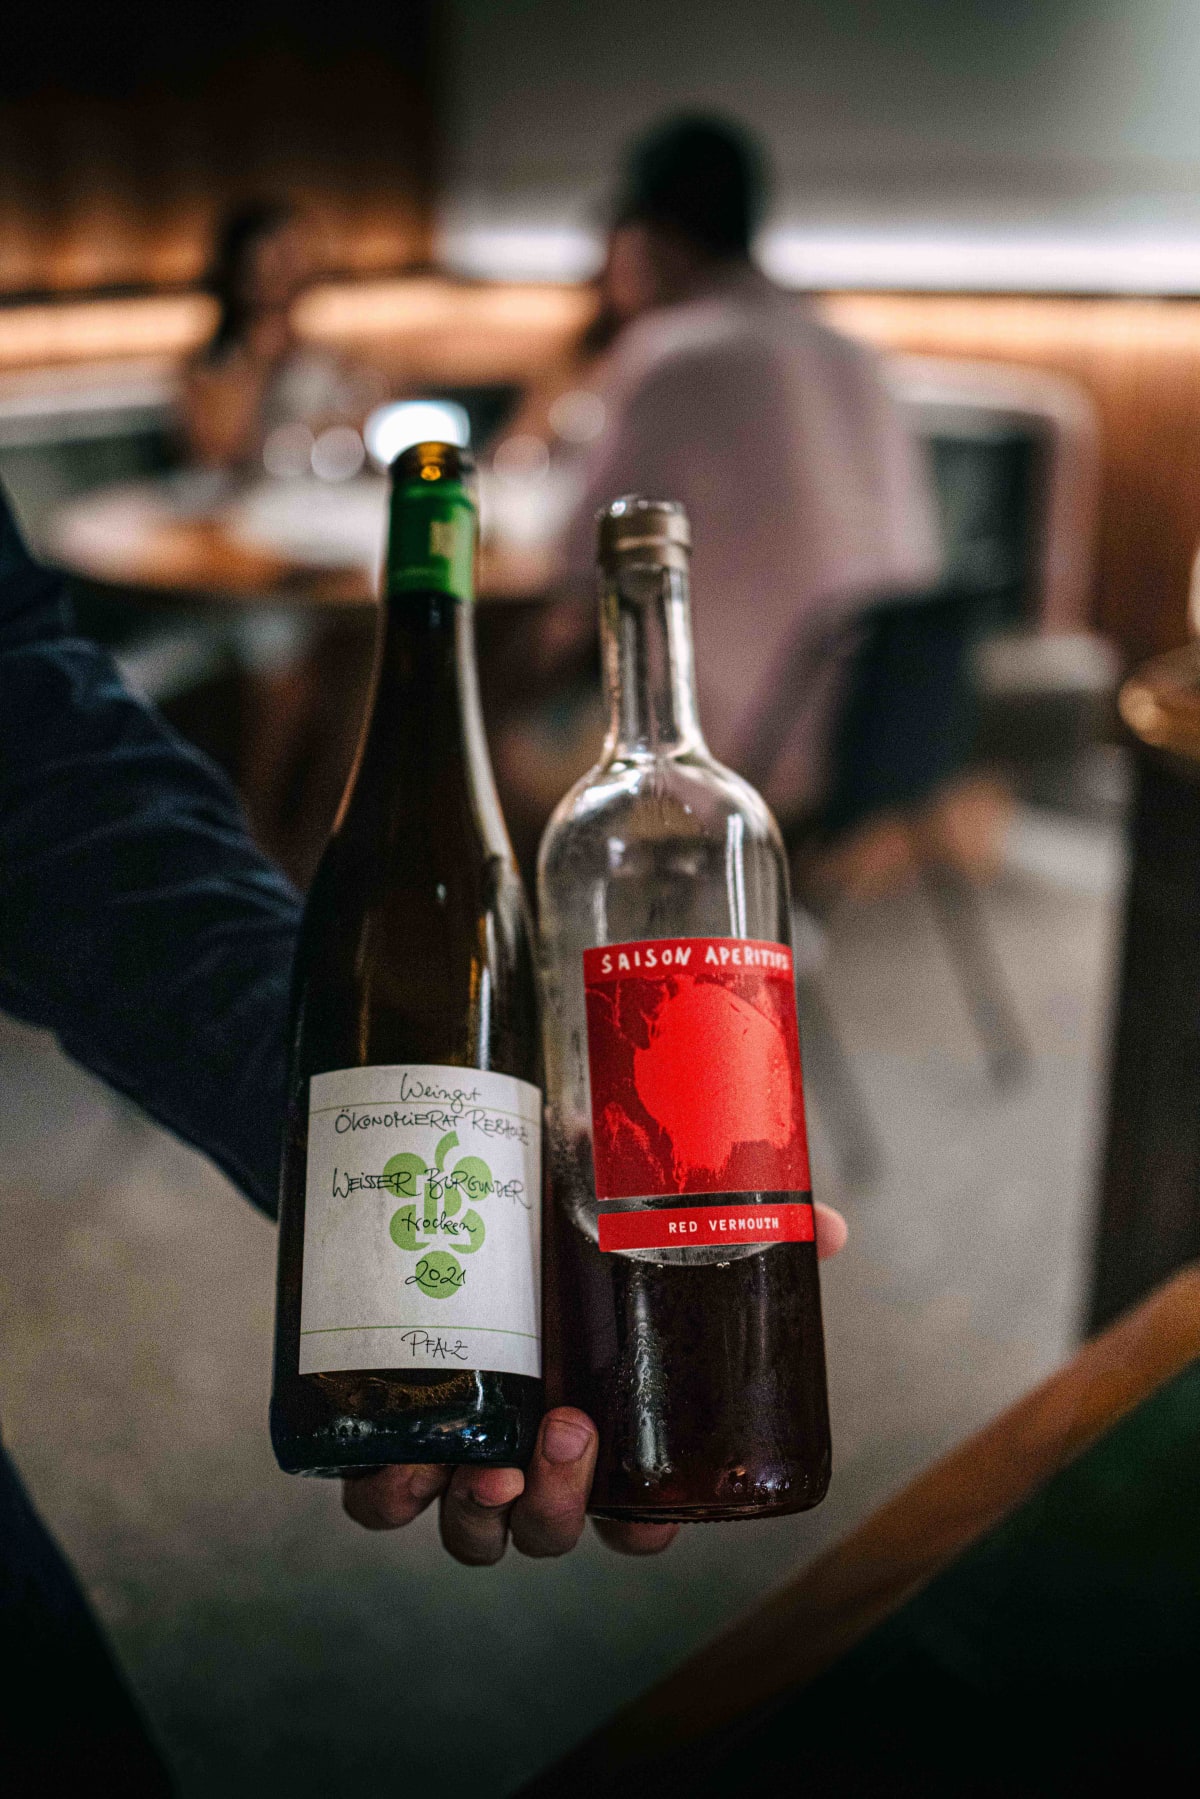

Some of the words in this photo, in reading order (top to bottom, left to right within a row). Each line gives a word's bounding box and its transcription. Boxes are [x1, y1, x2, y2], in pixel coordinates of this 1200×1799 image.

[601, 946, 691, 974] SAISON
[400, 1073, 481, 1113] Weingut
[401, 1211, 477, 1236] trocken
[668, 1221, 698, 1234] RED
[708, 1217, 780, 1232] VERMOUTH
[404, 1260, 467, 1288] 2021
[401, 1330, 469, 1360] PFALZ
